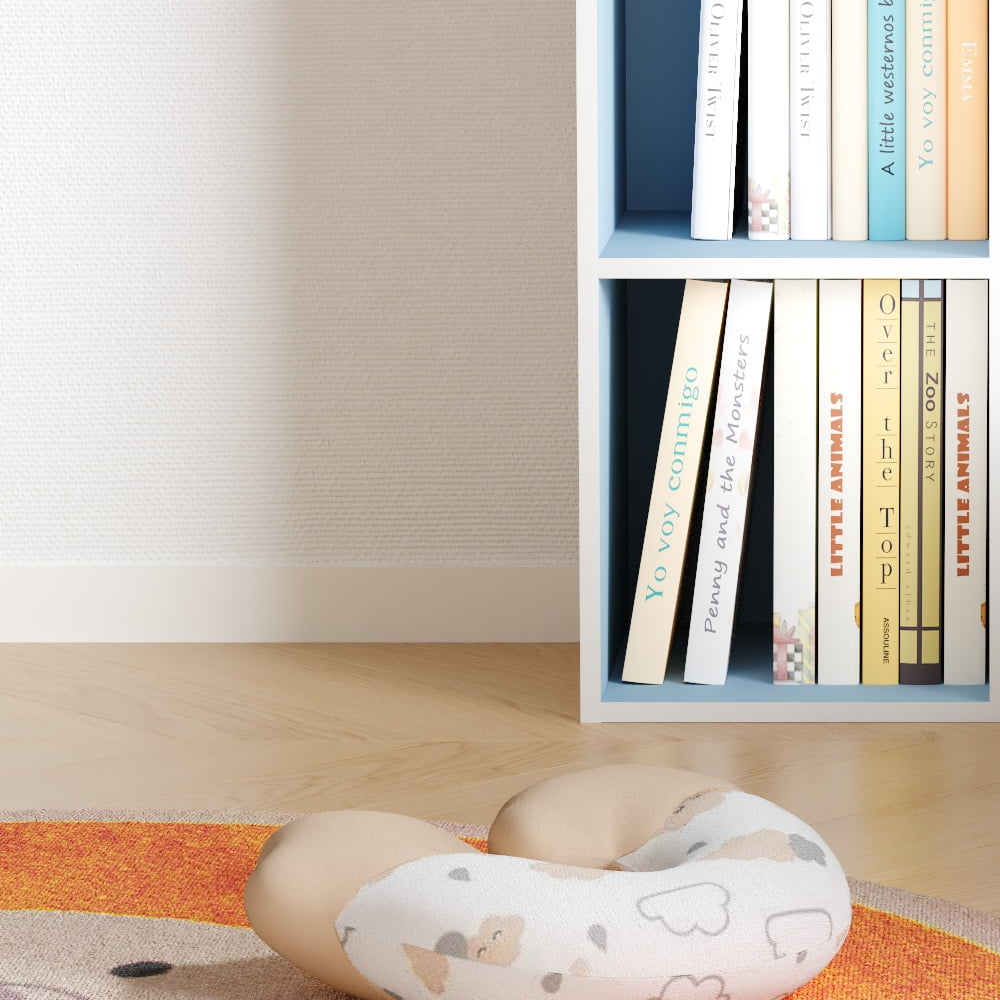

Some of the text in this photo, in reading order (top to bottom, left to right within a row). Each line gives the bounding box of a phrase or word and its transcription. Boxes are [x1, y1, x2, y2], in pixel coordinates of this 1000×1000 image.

[705, 3, 726, 138] OLIVER TWIST
[800, 1, 816, 138] OLIVER TWIST
[881, 14, 895, 106] westernos
[922, 87, 937, 129] voy
[961, 41, 978, 103] EMMA
[880, 112, 896, 155] little
[881, 161, 895, 176] A
[918, 139, 935, 171] Yo
[879, 293, 897, 586] Over the Top
[925, 322, 939, 483] THE ZOO STORY
[645, 366, 700, 602] Yo voy conmigo
[704, 333, 751, 634] Penny and the Monsters
[830, 392, 844, 577] LITTLE ANIMALS
[956, 392, 971, 577] LITTLE ANIMALS
[882, 617, 890, 664] ASSOULINE
